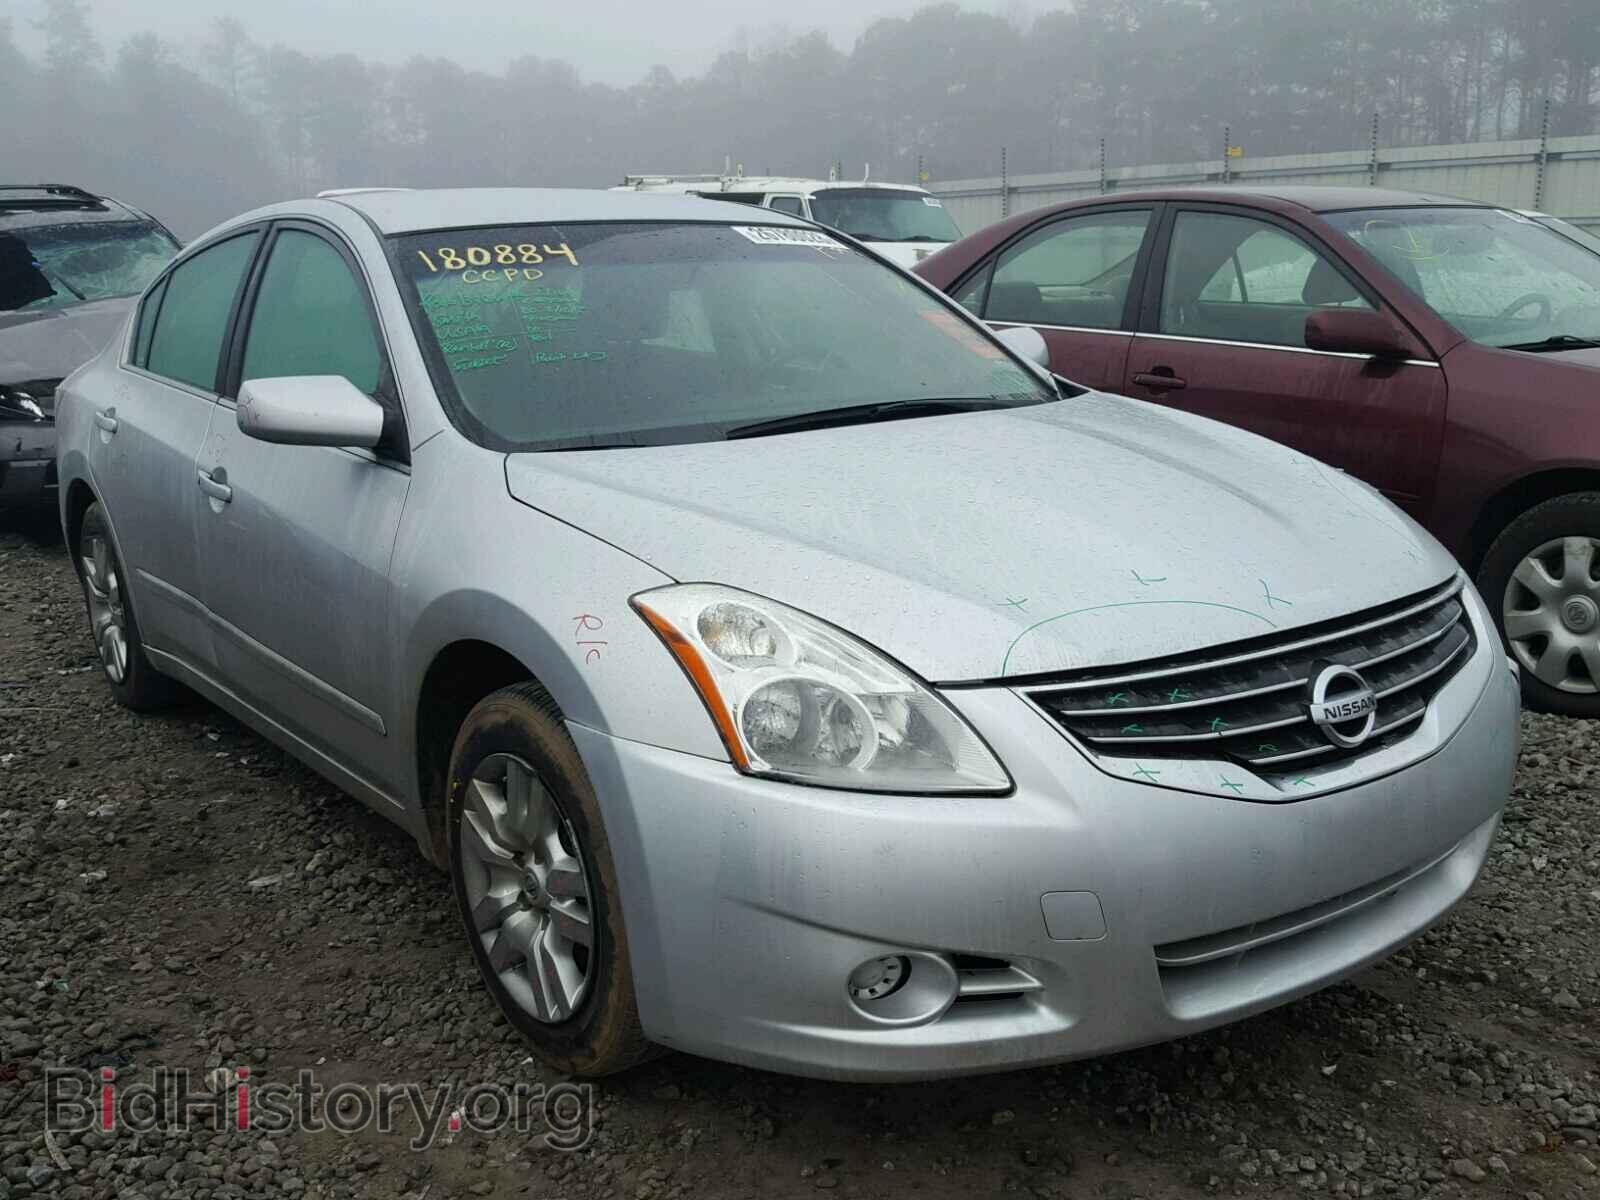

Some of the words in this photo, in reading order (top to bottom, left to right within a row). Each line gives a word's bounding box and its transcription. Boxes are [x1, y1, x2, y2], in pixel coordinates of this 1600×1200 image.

[418, 242, 579, 272] 180884
[462, 268, 544, 284] CCPD
[1323, 694, 1375, 720] NISSAN
